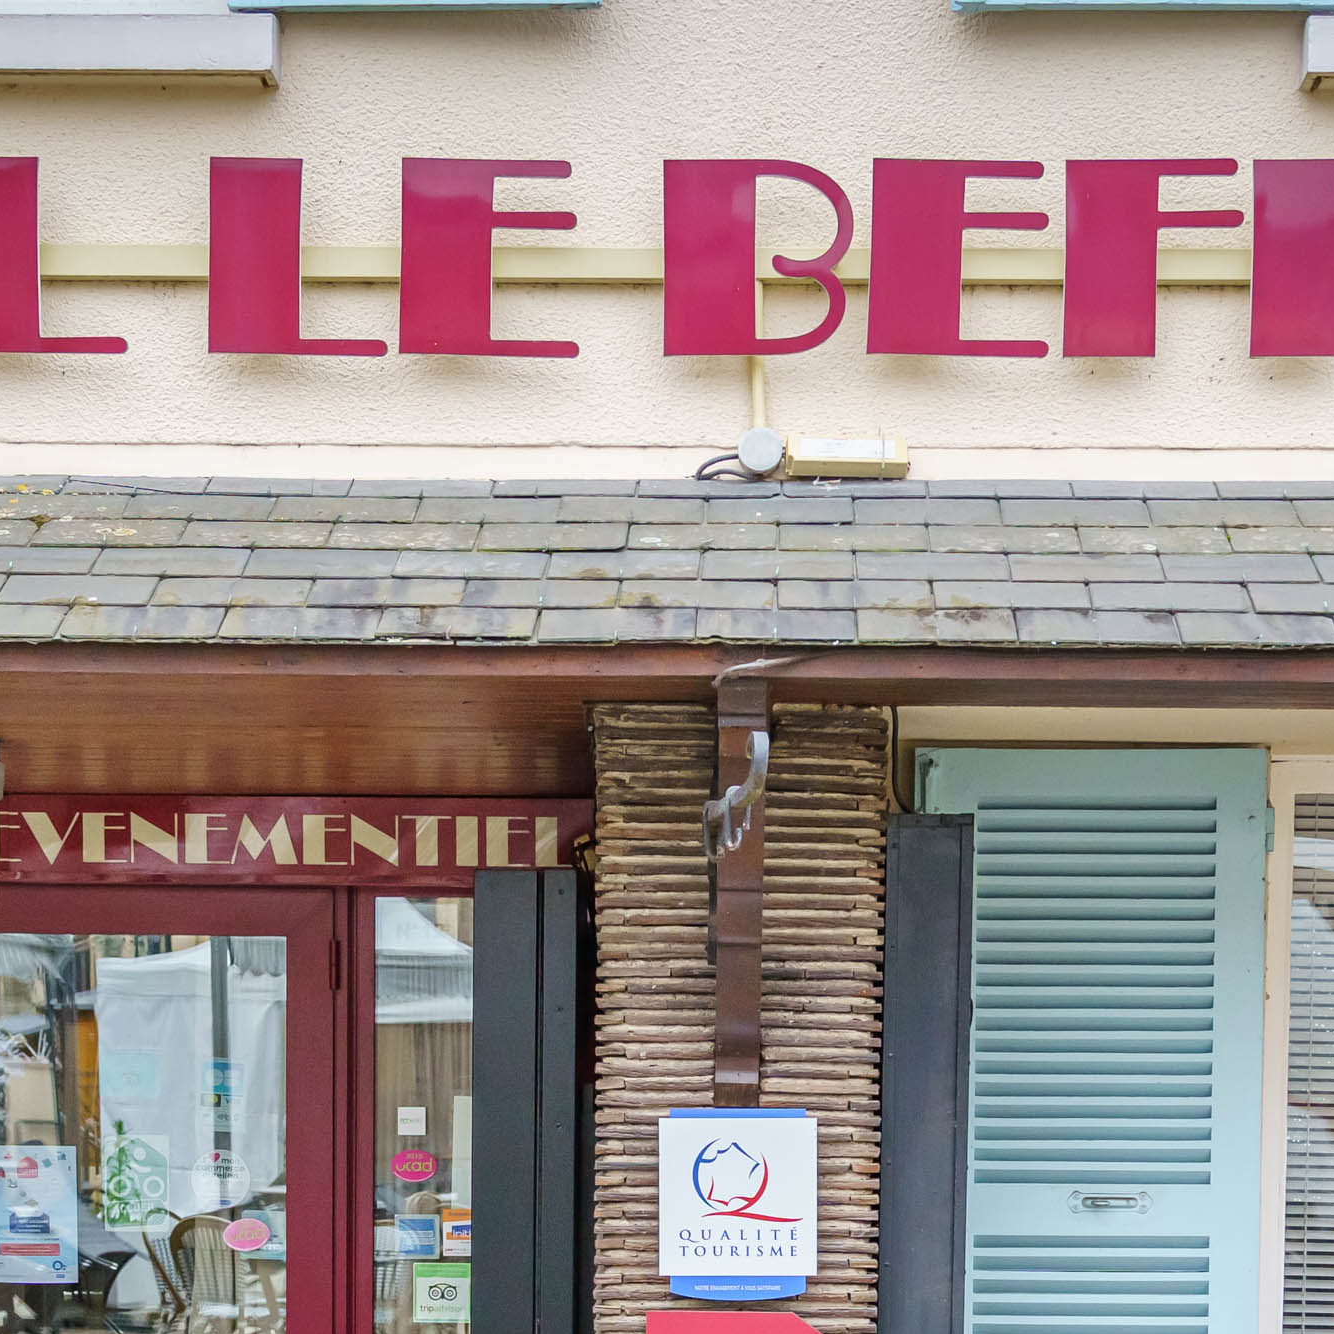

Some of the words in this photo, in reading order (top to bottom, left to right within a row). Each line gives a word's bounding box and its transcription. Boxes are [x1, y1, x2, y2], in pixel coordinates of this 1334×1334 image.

[208, 156, 579, 358] LE
[679, 1227, 799, 1243] QUALITÉ
[679, 1245, 798, 1257] TOURISME
